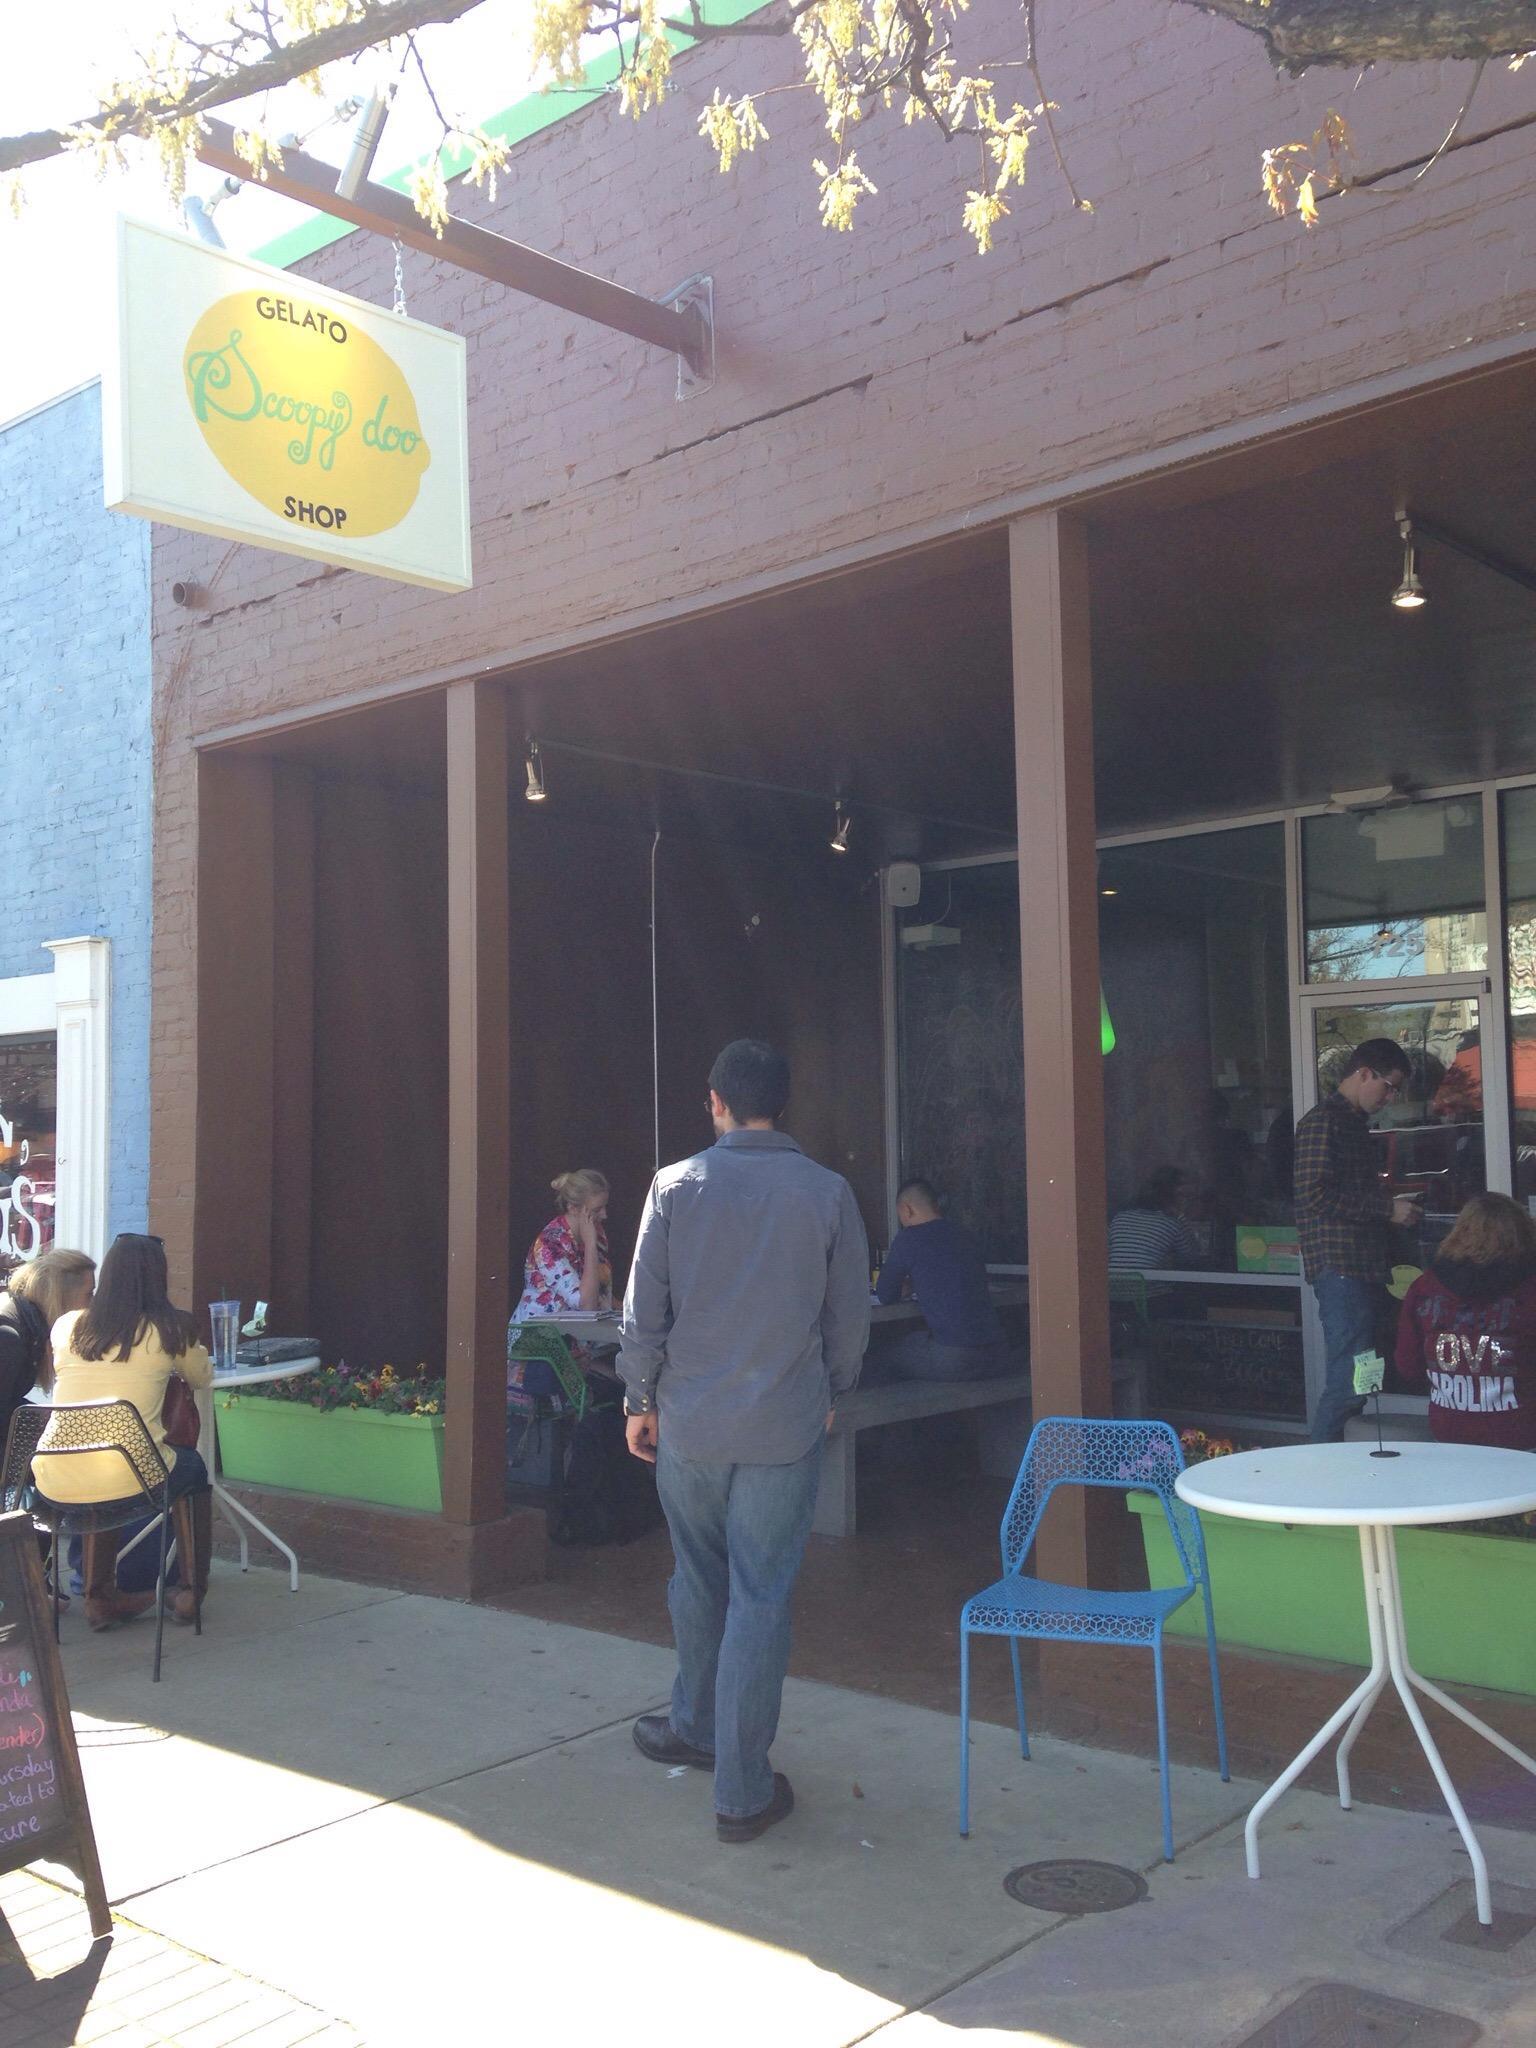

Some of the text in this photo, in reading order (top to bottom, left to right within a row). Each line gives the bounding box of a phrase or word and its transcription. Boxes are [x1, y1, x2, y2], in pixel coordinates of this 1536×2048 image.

[257, 296, 347, 344] GELATO
[188, 329, 424, 472] Scoopy doo
[284, 496, 347, 529] SHOP
[1373, 933, 1425, 959] 725
[1434, 1332, 1516, 1374] OVE
[38, 1783, 56, 1800] to
